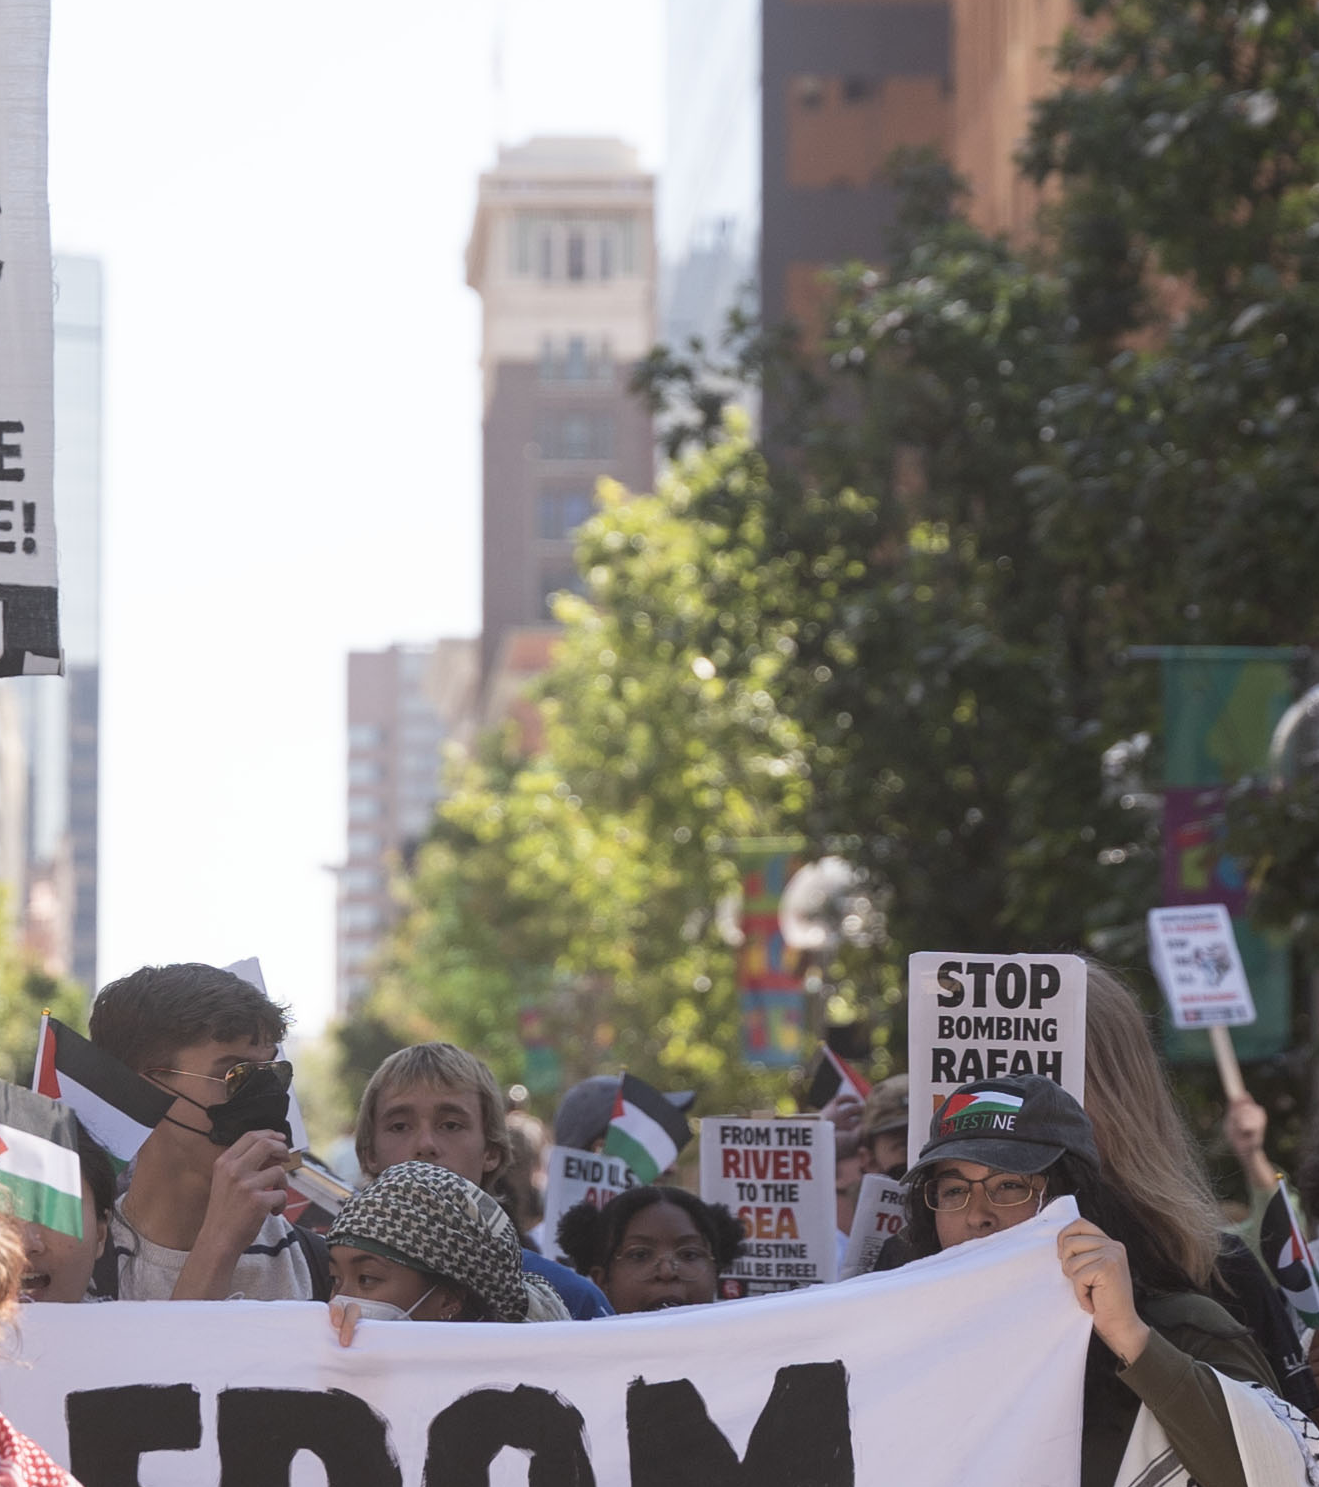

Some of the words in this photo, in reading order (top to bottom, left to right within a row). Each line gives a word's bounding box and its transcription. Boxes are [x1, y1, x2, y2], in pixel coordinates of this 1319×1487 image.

[937, 961, 1061, 1009] STOP
[938, 1015, 1058, 1042] BOMBING
[931, 1047, 1063, 1086] RAFAH
[720, 1125, 770, 1146] FROM
[775, 1127, 813, 1146] THE
[564, 1155, 603, 1184] END
[721, 1148, 813, 1180] RIVER
[736, 1182, 758, 1202] TO
[762, 1183, 800, 1203] THE
[737, 1205, 800, 1240] SEA
[875, 1211, 903, 1235] TO
[755, 1263, 773, 1277] BE
[776, 1264, 817, 1278] FREE!
